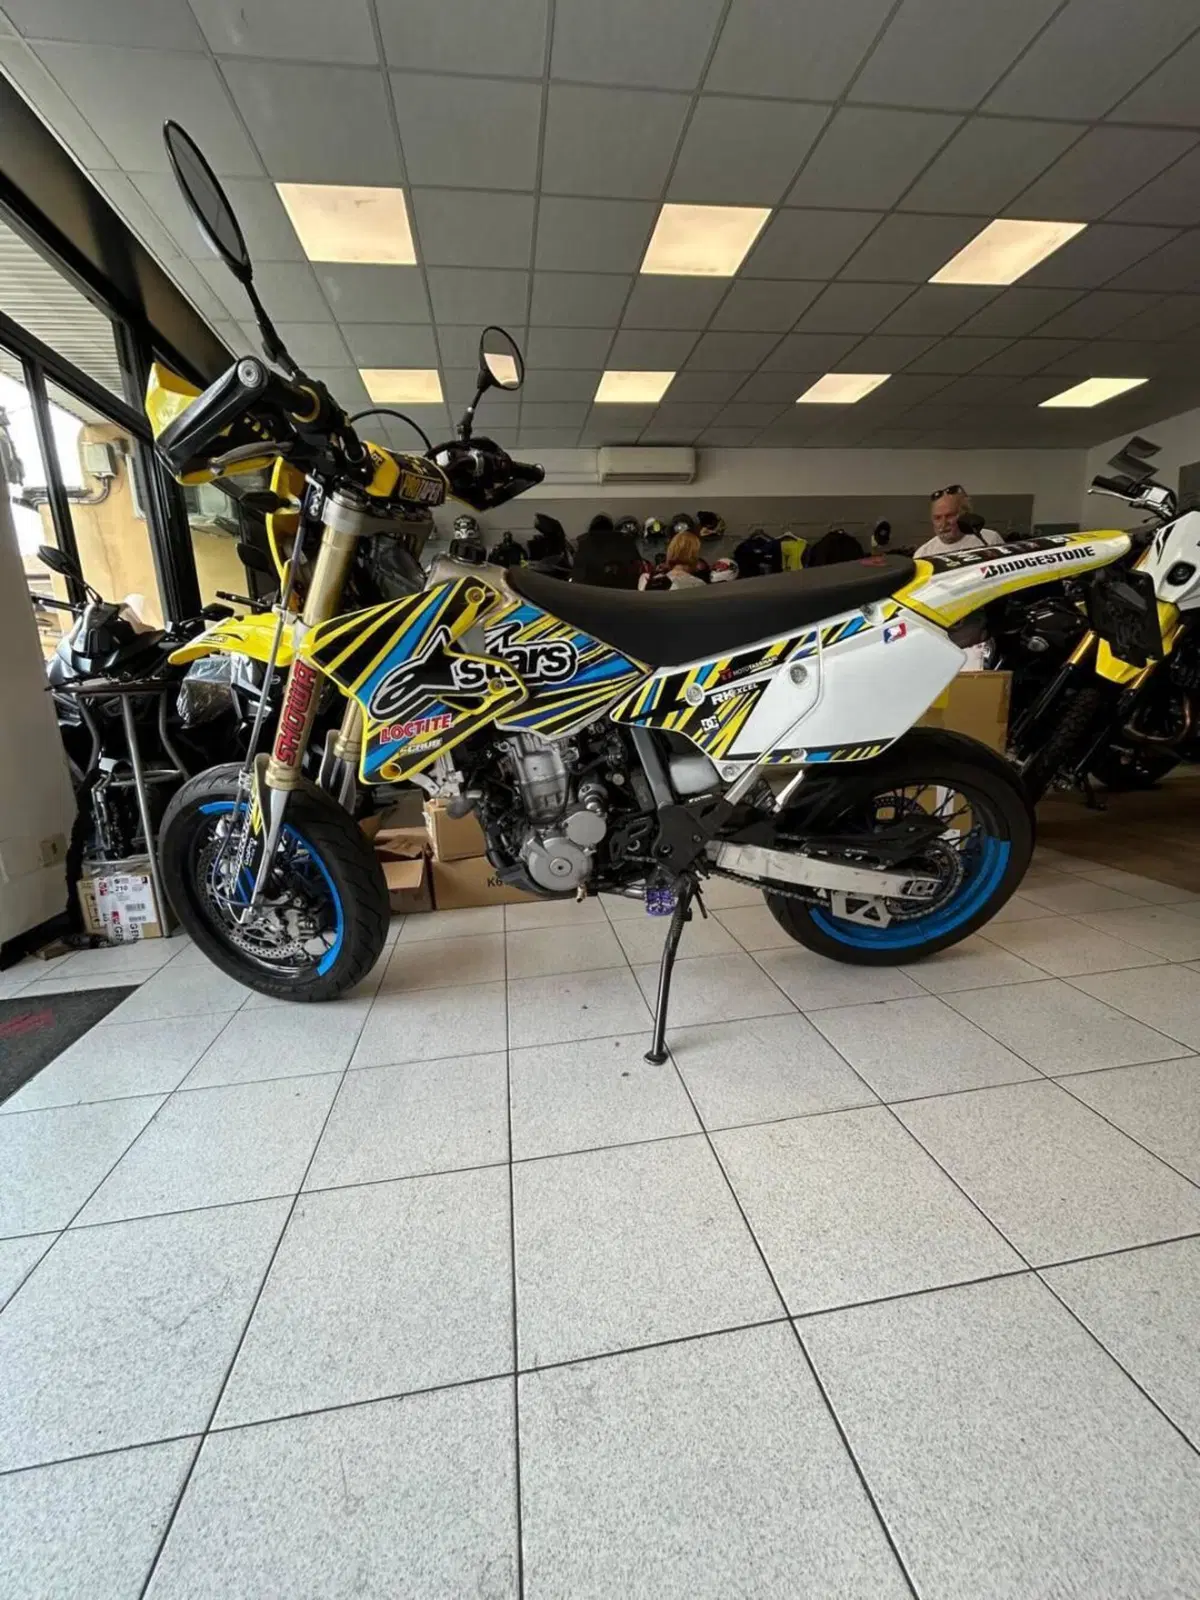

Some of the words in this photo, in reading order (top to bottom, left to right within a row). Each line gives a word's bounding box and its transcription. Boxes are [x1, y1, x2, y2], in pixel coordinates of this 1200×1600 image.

[980, 546, 1095, 579] BRIDGESTONE
[275, 659, 317, 766] SHOWA
[701, 716, 719, 731] DC
[380, 714, 453, 744] LOCTITE
